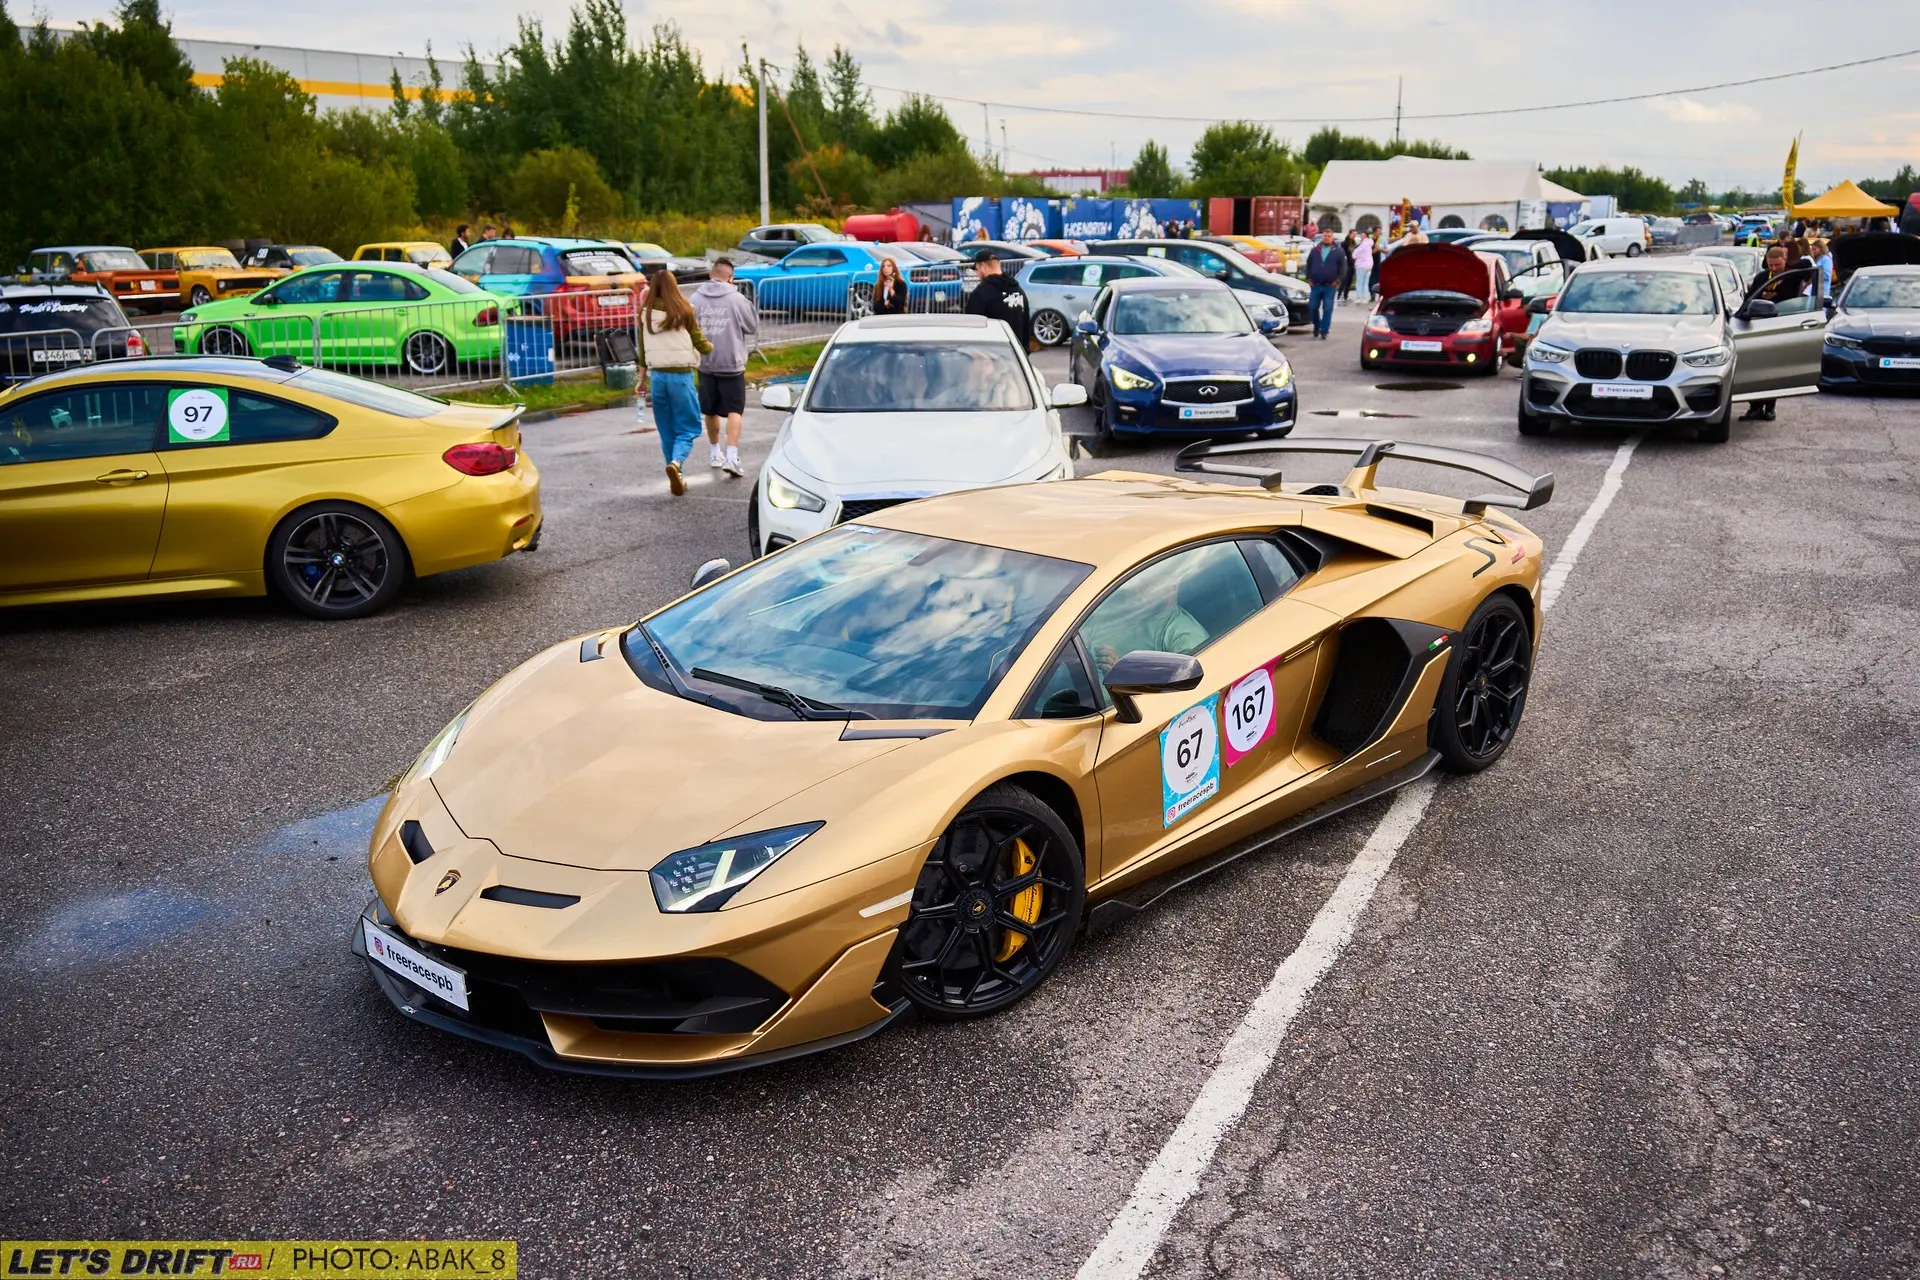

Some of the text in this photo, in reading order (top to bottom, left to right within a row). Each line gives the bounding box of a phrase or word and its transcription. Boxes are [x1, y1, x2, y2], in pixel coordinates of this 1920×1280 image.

[184, 406, 213, 423] 97
[1232, 685, 1266, 731] 167
[1177, 728, 1203, 768] 67
[1178, 782, 1214, 812] freeracespb
[387, 945, 453, 991] freeracespb
